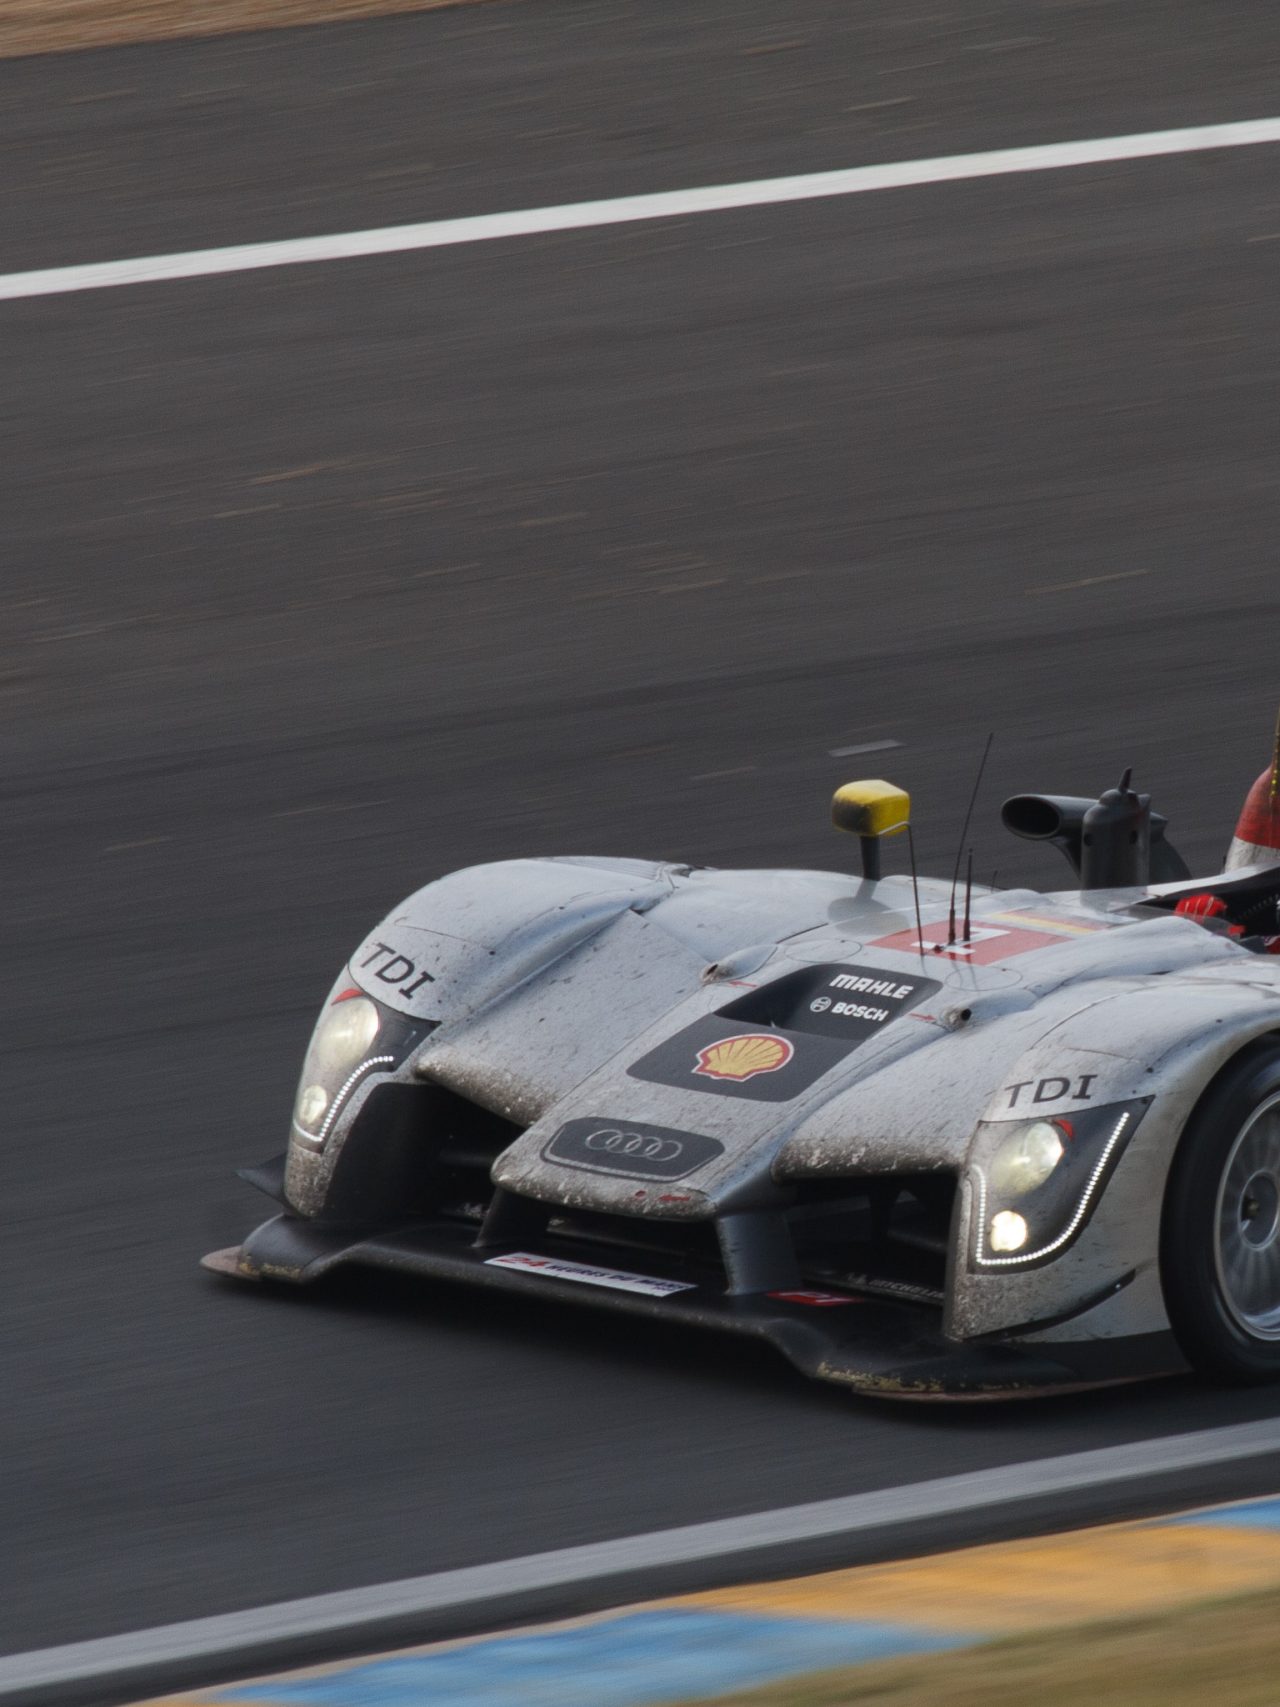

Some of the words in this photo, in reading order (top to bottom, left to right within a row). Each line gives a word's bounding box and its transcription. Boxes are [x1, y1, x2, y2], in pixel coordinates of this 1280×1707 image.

[360, 942, 435, 1000] TDI
[829, 973, 914, 999] MAHLE
[831, 1002, 889, 1021] BOSCH
[1004, 1074, 1098, 1108] TDI
